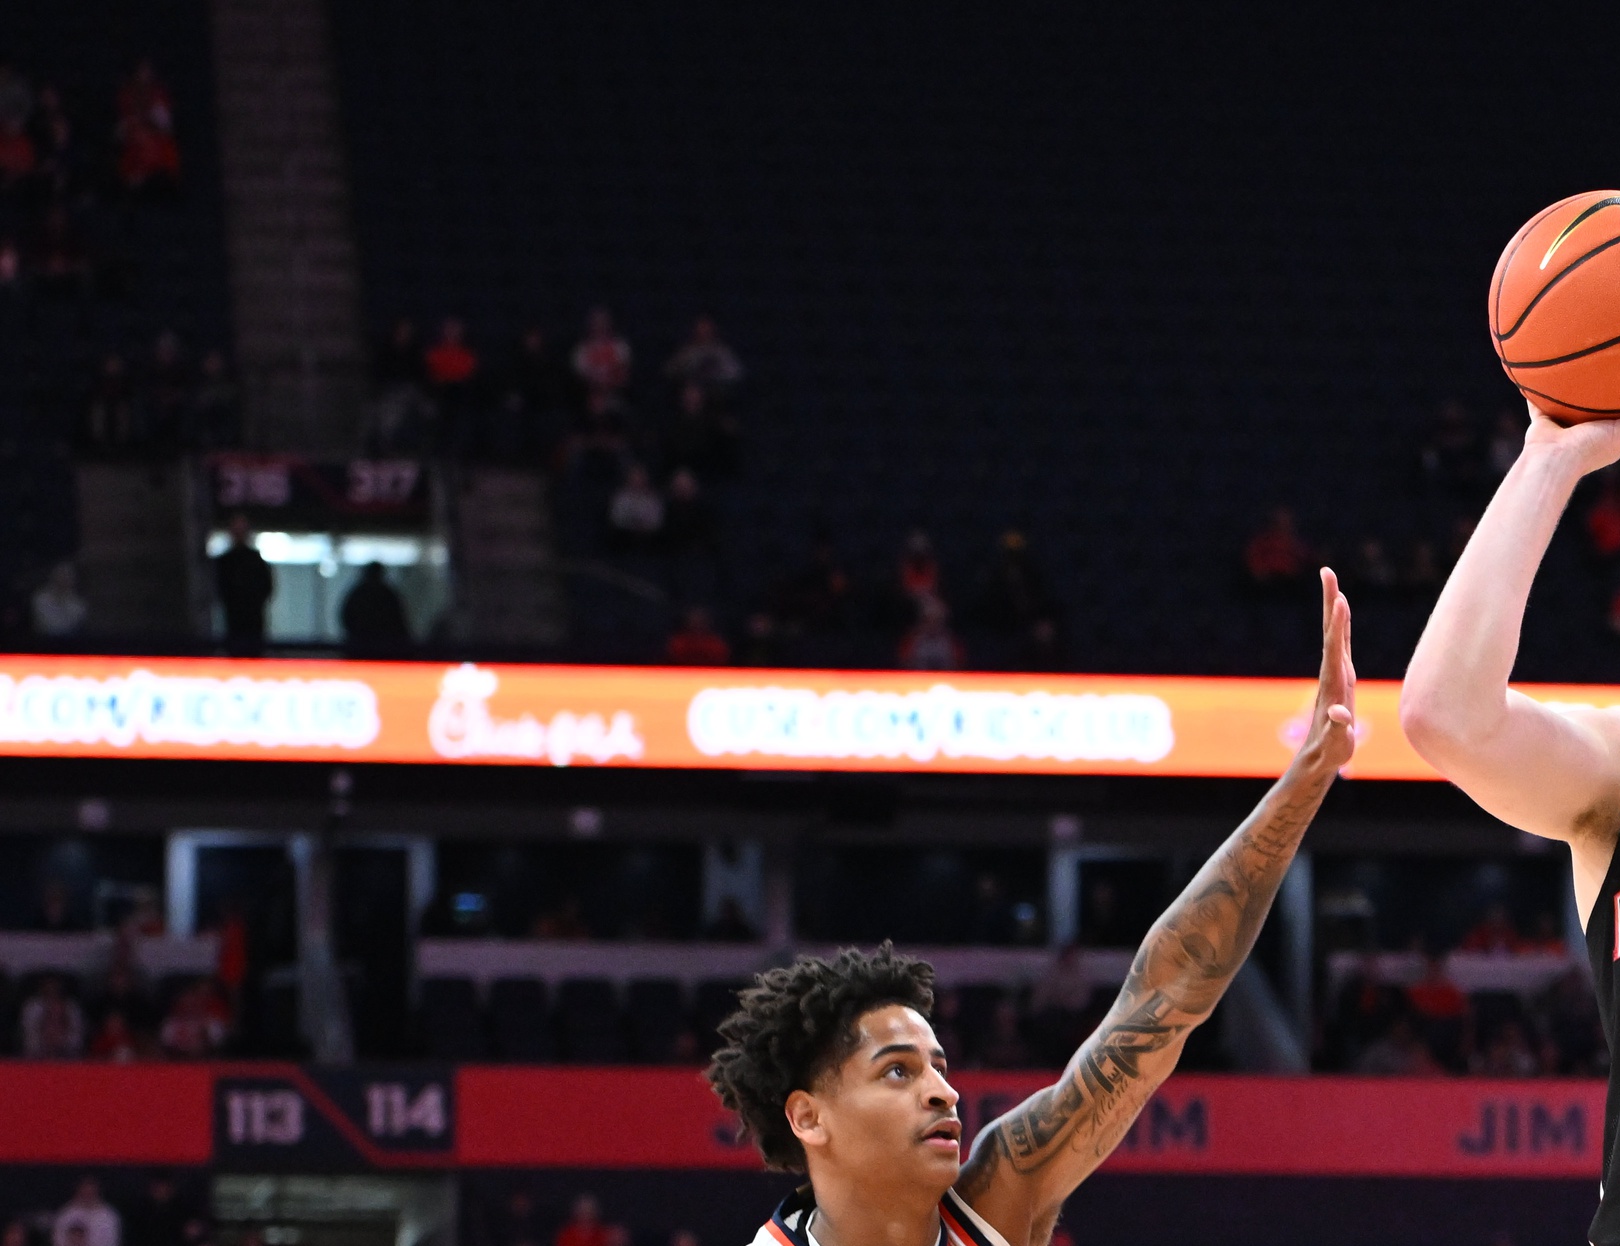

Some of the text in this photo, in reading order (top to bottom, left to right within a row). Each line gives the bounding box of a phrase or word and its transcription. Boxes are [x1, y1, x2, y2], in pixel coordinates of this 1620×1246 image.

[226, 1083, 446, 1144] 113 114
[1457, 1101, 1588, 1156] JIM
